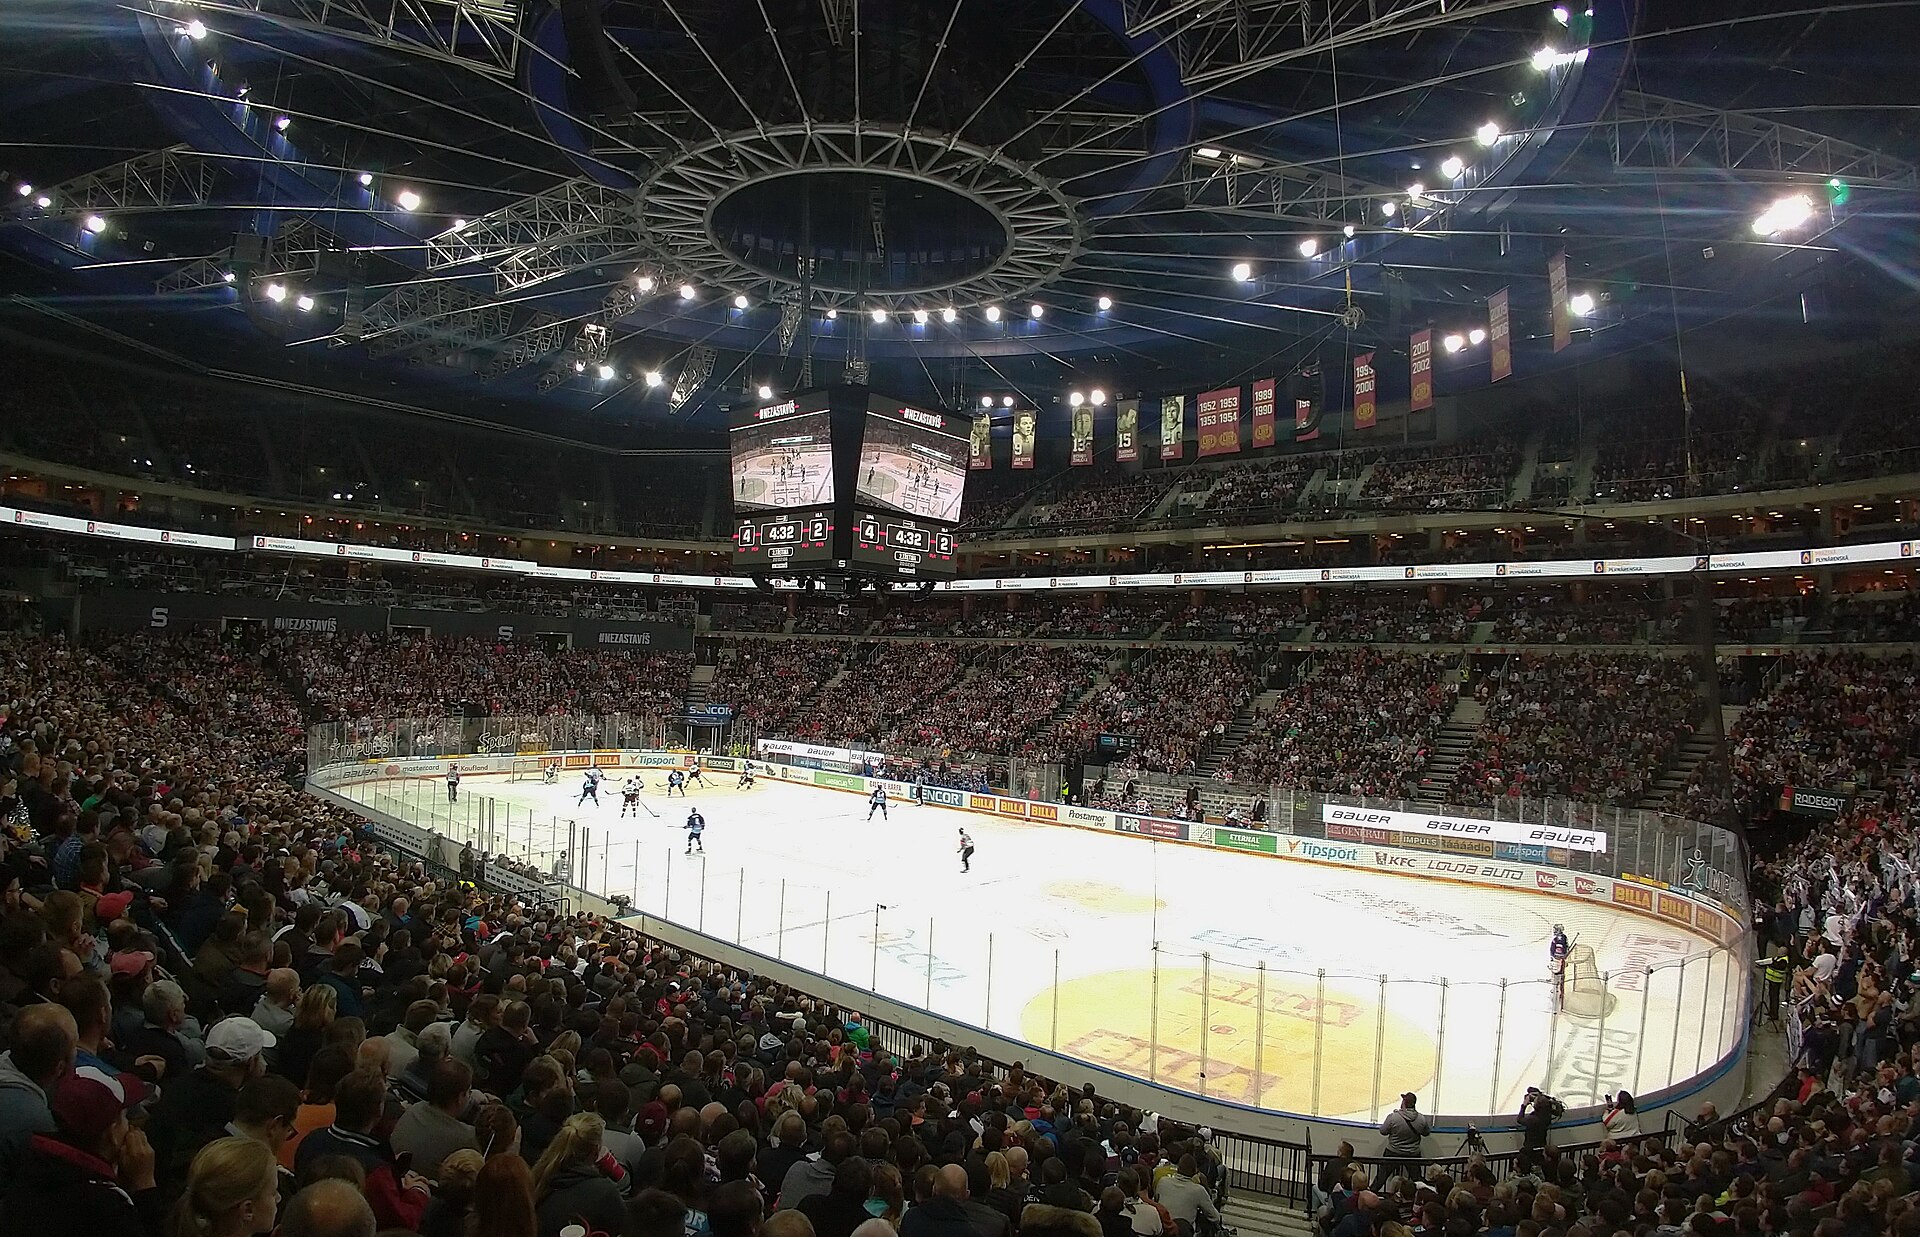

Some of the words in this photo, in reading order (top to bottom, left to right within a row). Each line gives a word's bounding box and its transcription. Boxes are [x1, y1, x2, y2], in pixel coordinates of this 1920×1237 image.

[1413, 339, 1430, 357] 2001
[1413, 357, 1431, 374] 2002
[1356, 380, 1375, 395] 2000
[1255, 389, 1273, 401] 1989
[1200, 401, 1217, 412] 1952
[1220, 397, 1238, 408] 1953
[1255, 404, 1273, 416] 1990
[1200, 415, 1217, 427] 1953
[1219, 412, 1237, 423] 1954
[1072, 438, 1084, 452] 13
[1118, 433, 1132, 447] 15
[1163, 431, 1176, 445] 21
[972, 444, 979, 456] 8
[1014, 442, 1022, 455] 9
[743, 529, 750, 542] 4
[769, 526, 794, 540] 4:32
[814, 522, 823, 537] 2
[864, 524, 874, 539] 4
[895, 532, 922, 547] 4:32
[940, 535, 949, 550] 2
[151, 607, 168, 628] S
[599, 632, 650, 645] #NEZASTAVÍŠ
[689, 706, 733, 715] SNCOR
[566, 756, 590, 766] BILLA
[595, 755, 619, 765] BILLA
[639, 755, 675, 766] Tipsport
[343, 769, 379, 778] BAUER
[460, 764, 489, 772] Kaufland
[972, 797, 994, 809] BILLA
[1001, 801, 1024, 813] BILLA
[1031, 805, 1056, 819] BILLA
[1069, 809, 1106, 823] Prostamol
[1332, 810, 1391, 824] BAUER
[1341, 827, 1386, 840] GENERALI
[1427, 821, 1491, 835] BAUER
[1229, 834, 1260, 843] ETERNAL
[1403, 836, 1437, 846] IMPULS
[1529, 831, 1597, 846] BAUER
[1301, 842, 1357, 861] Tipsport
[1388, 857, 1417, 868] KFC
[1427, 859, 1478, 875] LOUDA
[1481, 866, 1523, 880] AUTO
[1614, 886, 1650, 908] BILLA
[1661, 897, 1690, 920] BILLA
